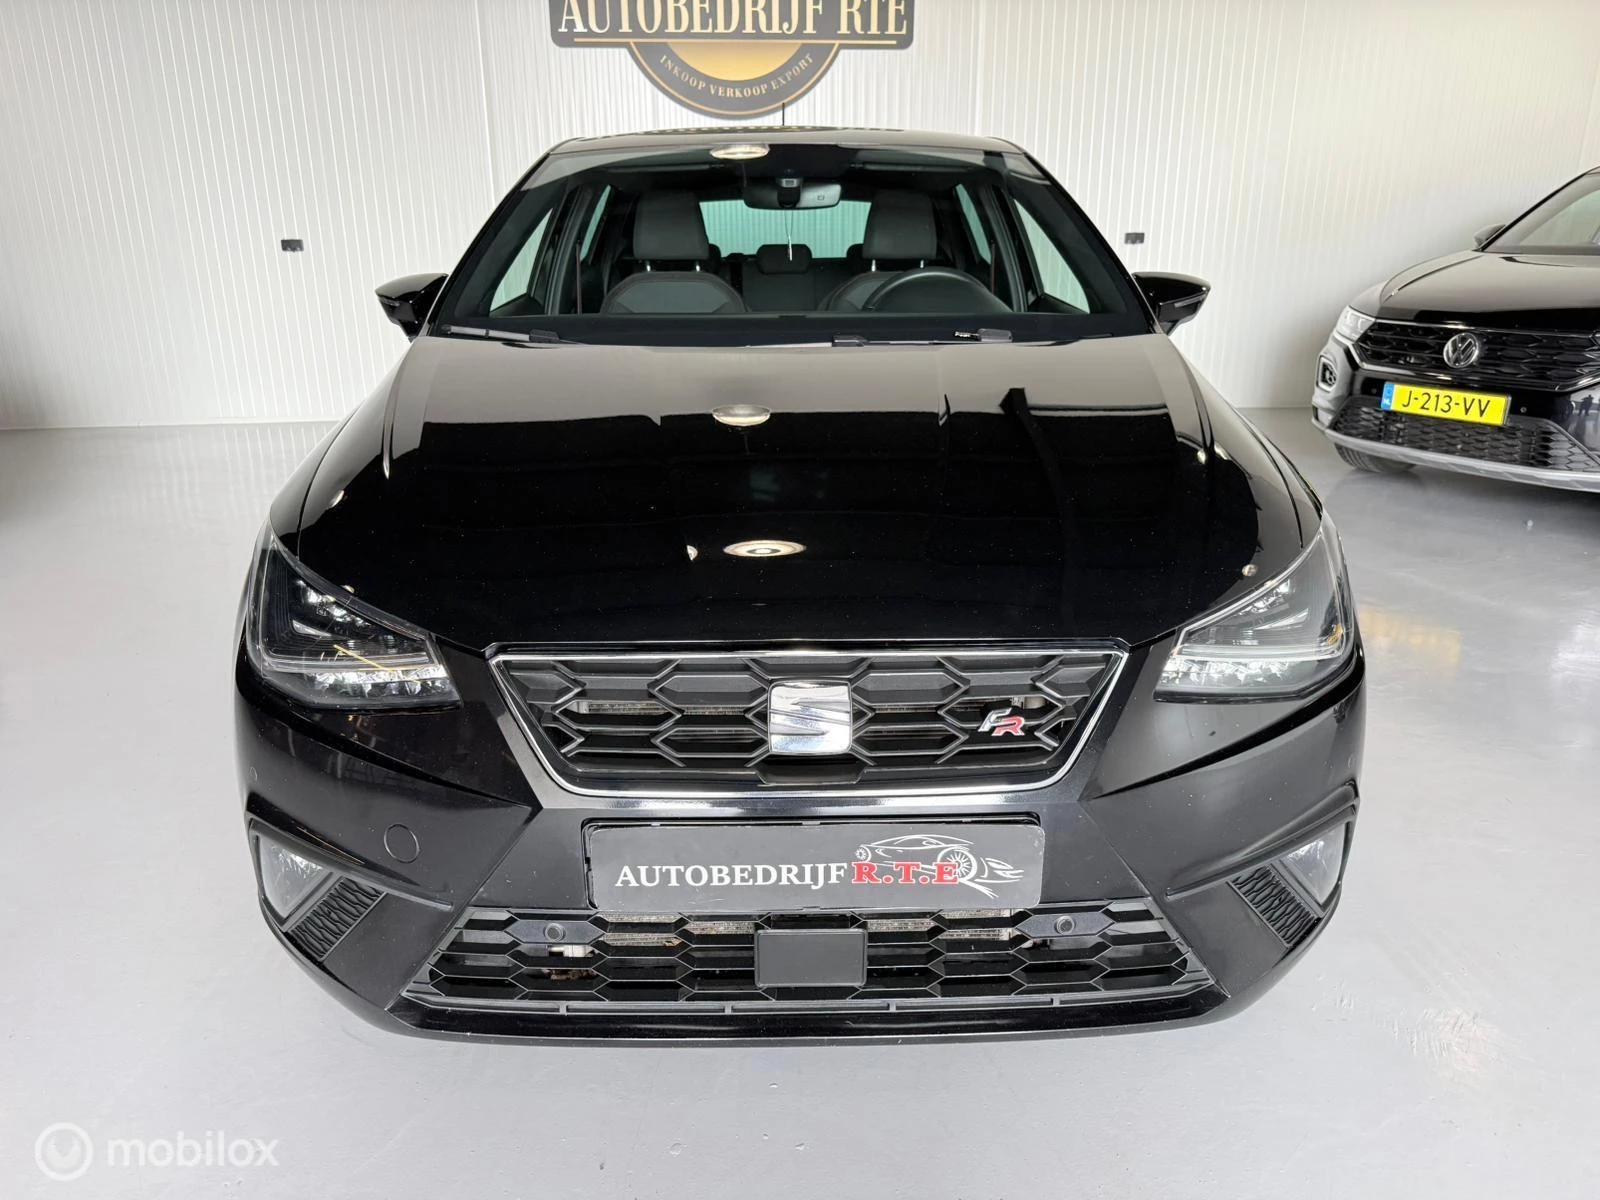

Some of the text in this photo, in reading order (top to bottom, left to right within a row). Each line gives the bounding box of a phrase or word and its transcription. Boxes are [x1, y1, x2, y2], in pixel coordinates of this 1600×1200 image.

[558, 0, 907, 35] AUTOBEDRIJF RTE
[660, 53, 814, 98] INKOOP VERKOOP EXPORT
[1402, 390, 1490, 418] J-213-VV
[615, 861, 959, 890] AUTOBEDRIJF R.T.E
